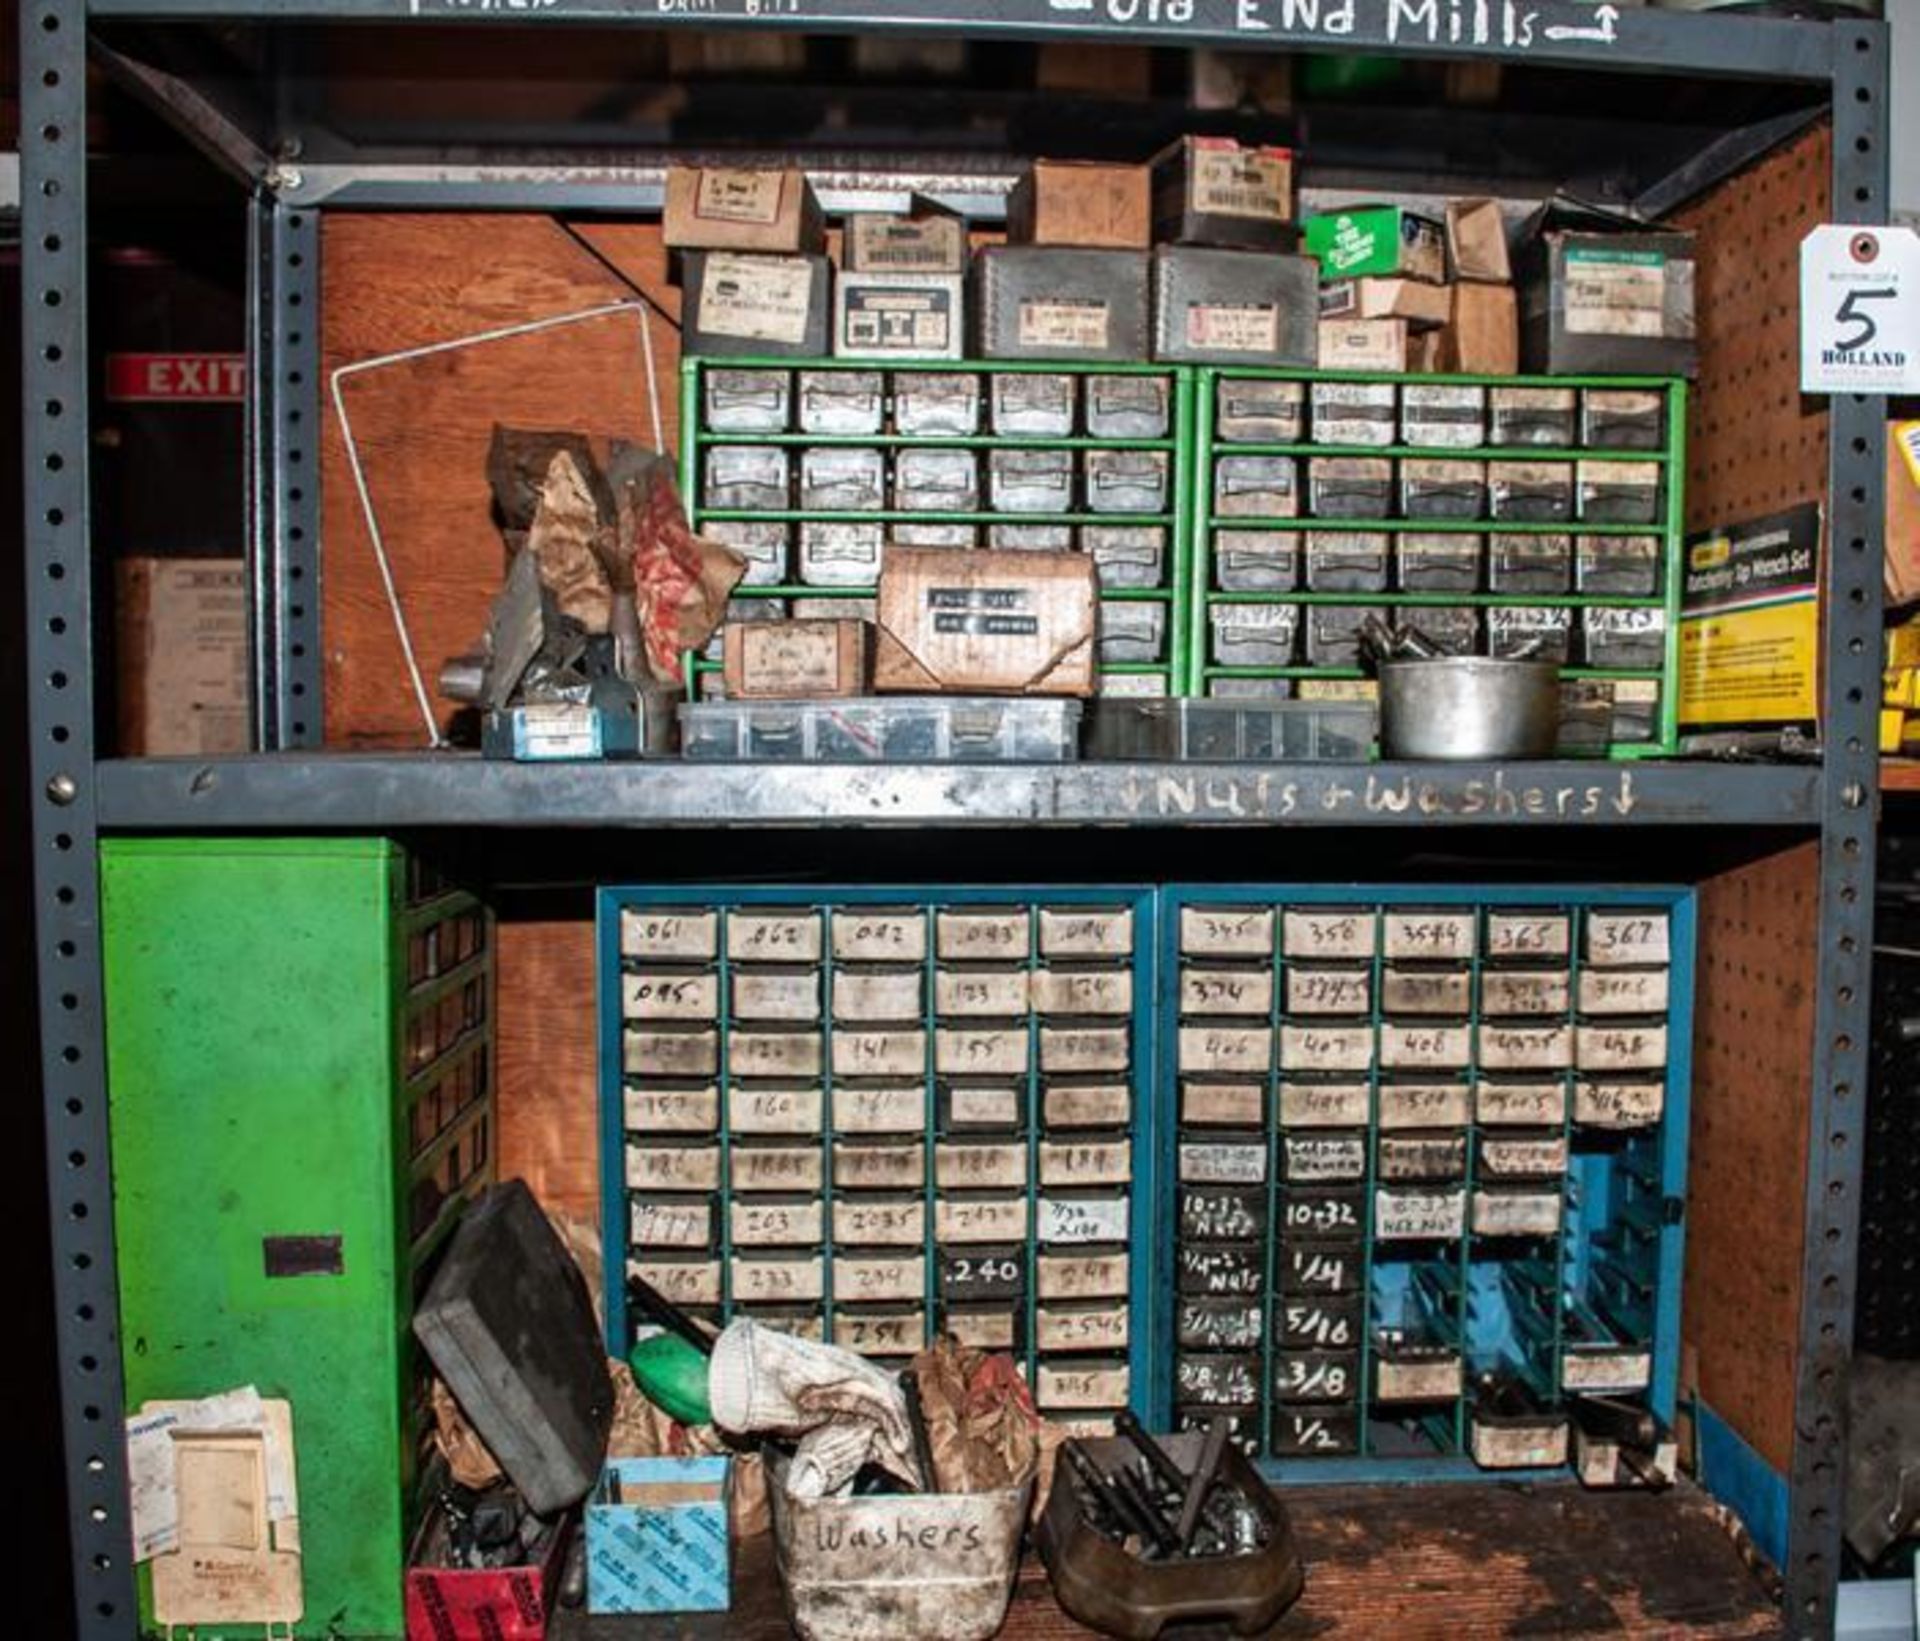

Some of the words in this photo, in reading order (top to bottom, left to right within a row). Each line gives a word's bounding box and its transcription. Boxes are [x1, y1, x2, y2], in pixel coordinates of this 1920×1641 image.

[1835, 286, 1898, 350] 5
[1822, 350, 1906, 367] HOLLAND
[147, 361, 247, 393] EXIT
[1365, 772, 1602, 812] Washers
[1287, 1201, 1357, 1227] 10-32
[944, 1259, 1019, 1283] .240
[1294, 1251, 1344, 1291] 1/4
[1286, 1307, 1349, 1344] 5/16
[1294, 1416, 1340, 1448] 1/2
[815, 1516, 984, 1552] Washers
